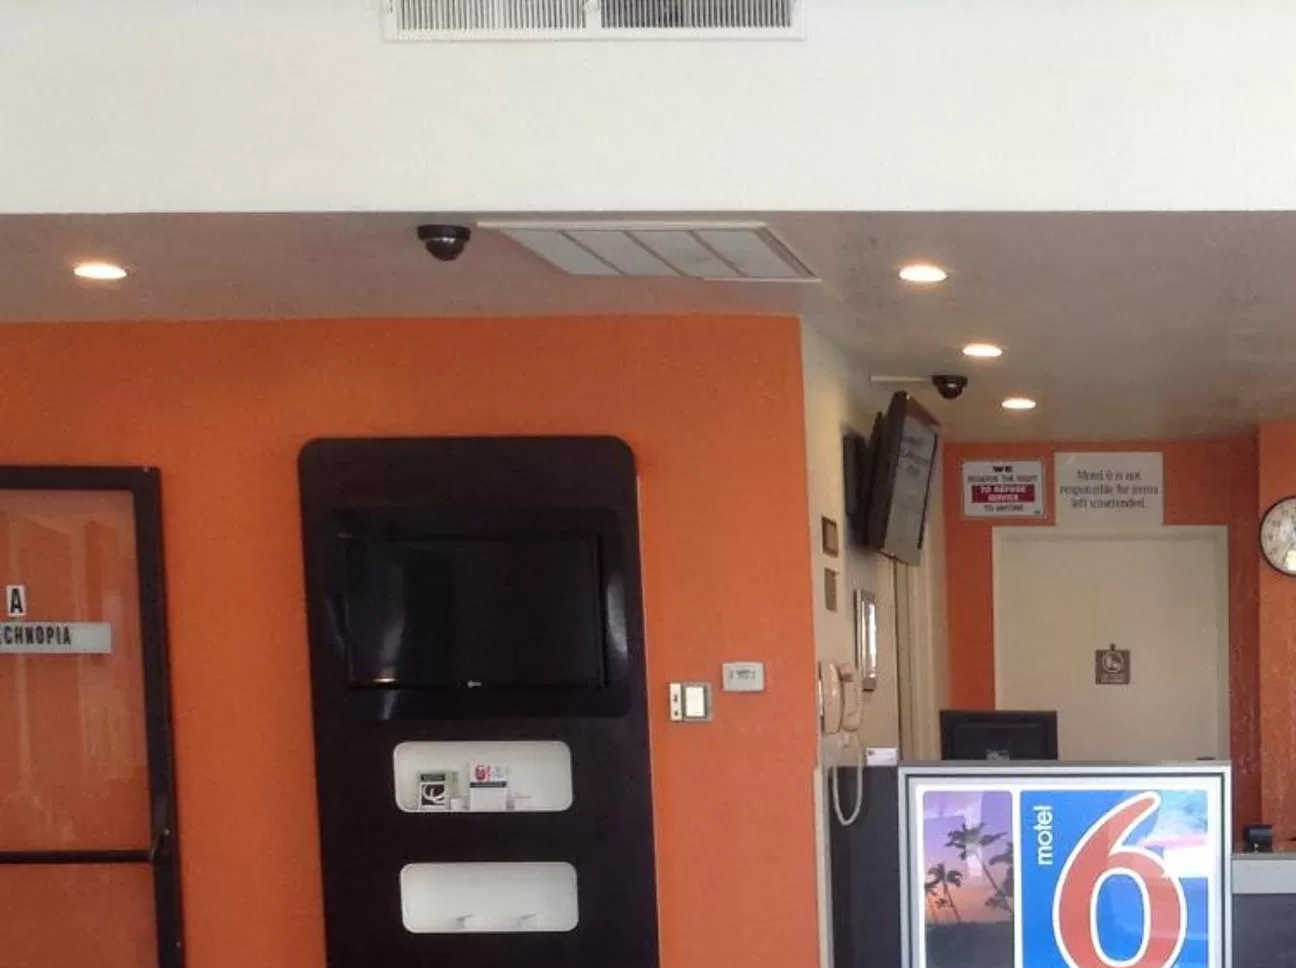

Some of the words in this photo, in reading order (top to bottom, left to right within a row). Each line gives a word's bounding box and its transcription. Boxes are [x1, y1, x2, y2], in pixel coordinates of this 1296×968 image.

[10, 588, 23, 613] A
[0, 625, 72, 645] CHNOPIA
[1033, 805, 1053, 865] motel
